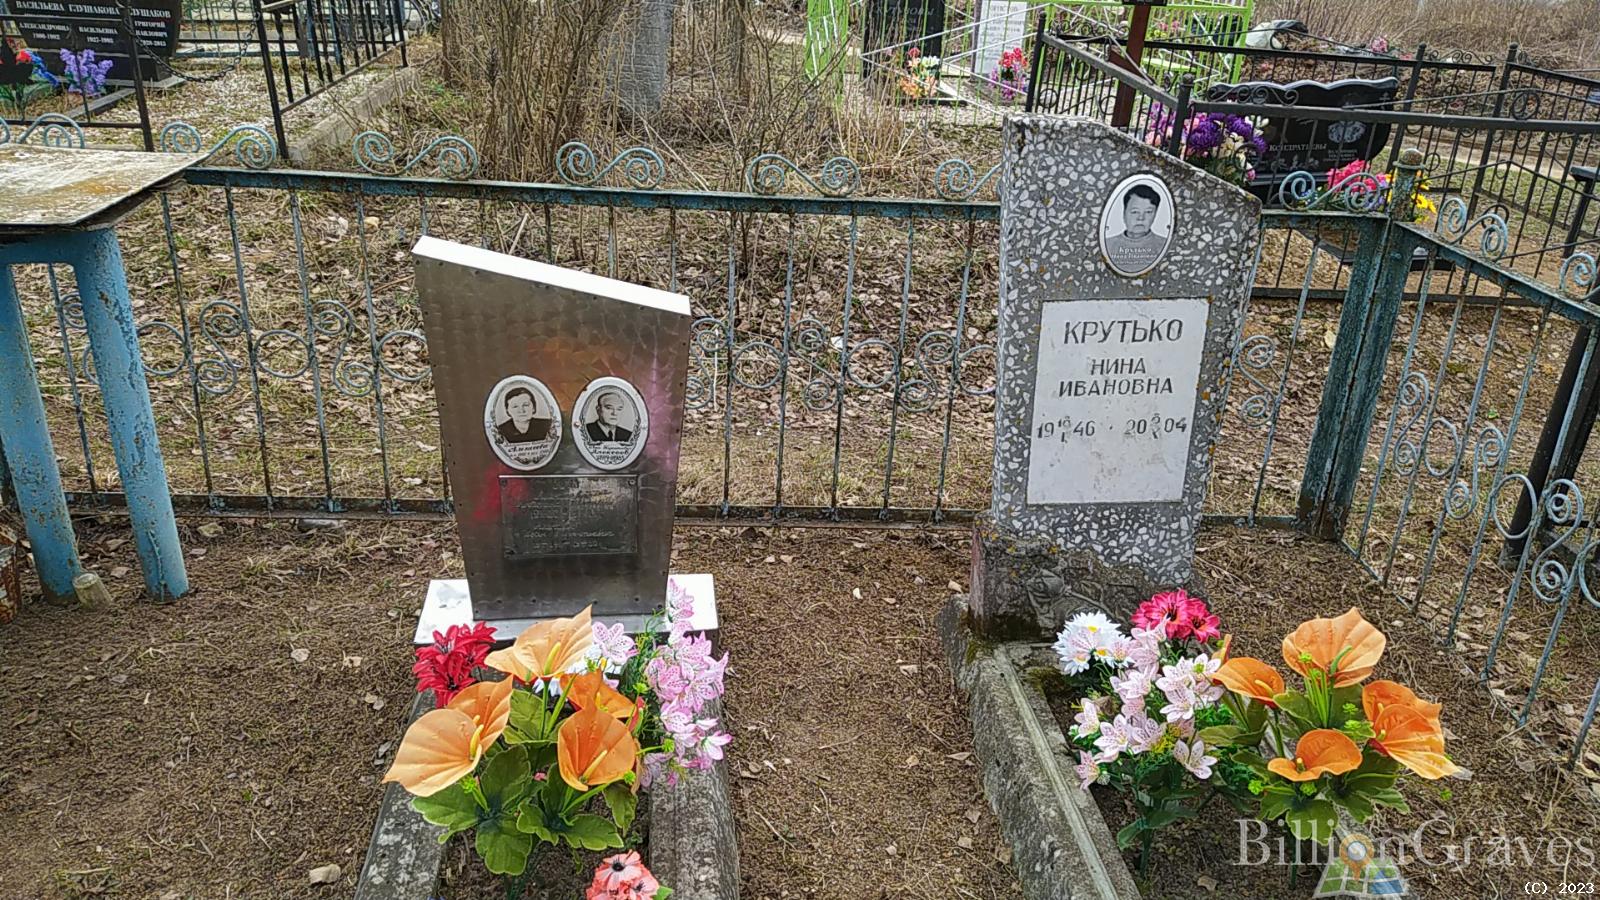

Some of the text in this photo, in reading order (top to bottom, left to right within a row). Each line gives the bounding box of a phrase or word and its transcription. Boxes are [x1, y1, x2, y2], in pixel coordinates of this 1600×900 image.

[16, 1, 65, 11] ВАСИЛЬЕВА
[68, 4, 120, 15] ГЛУШАКОВА
[129, 7, 171, 18] ЛУШАКОВ
[1063, 319, 1184, 344] КРУТЬКО
[1090, 357, 1147, 376] НИНА
[1058, 377, 1174, 398] ИВАНОВНА
